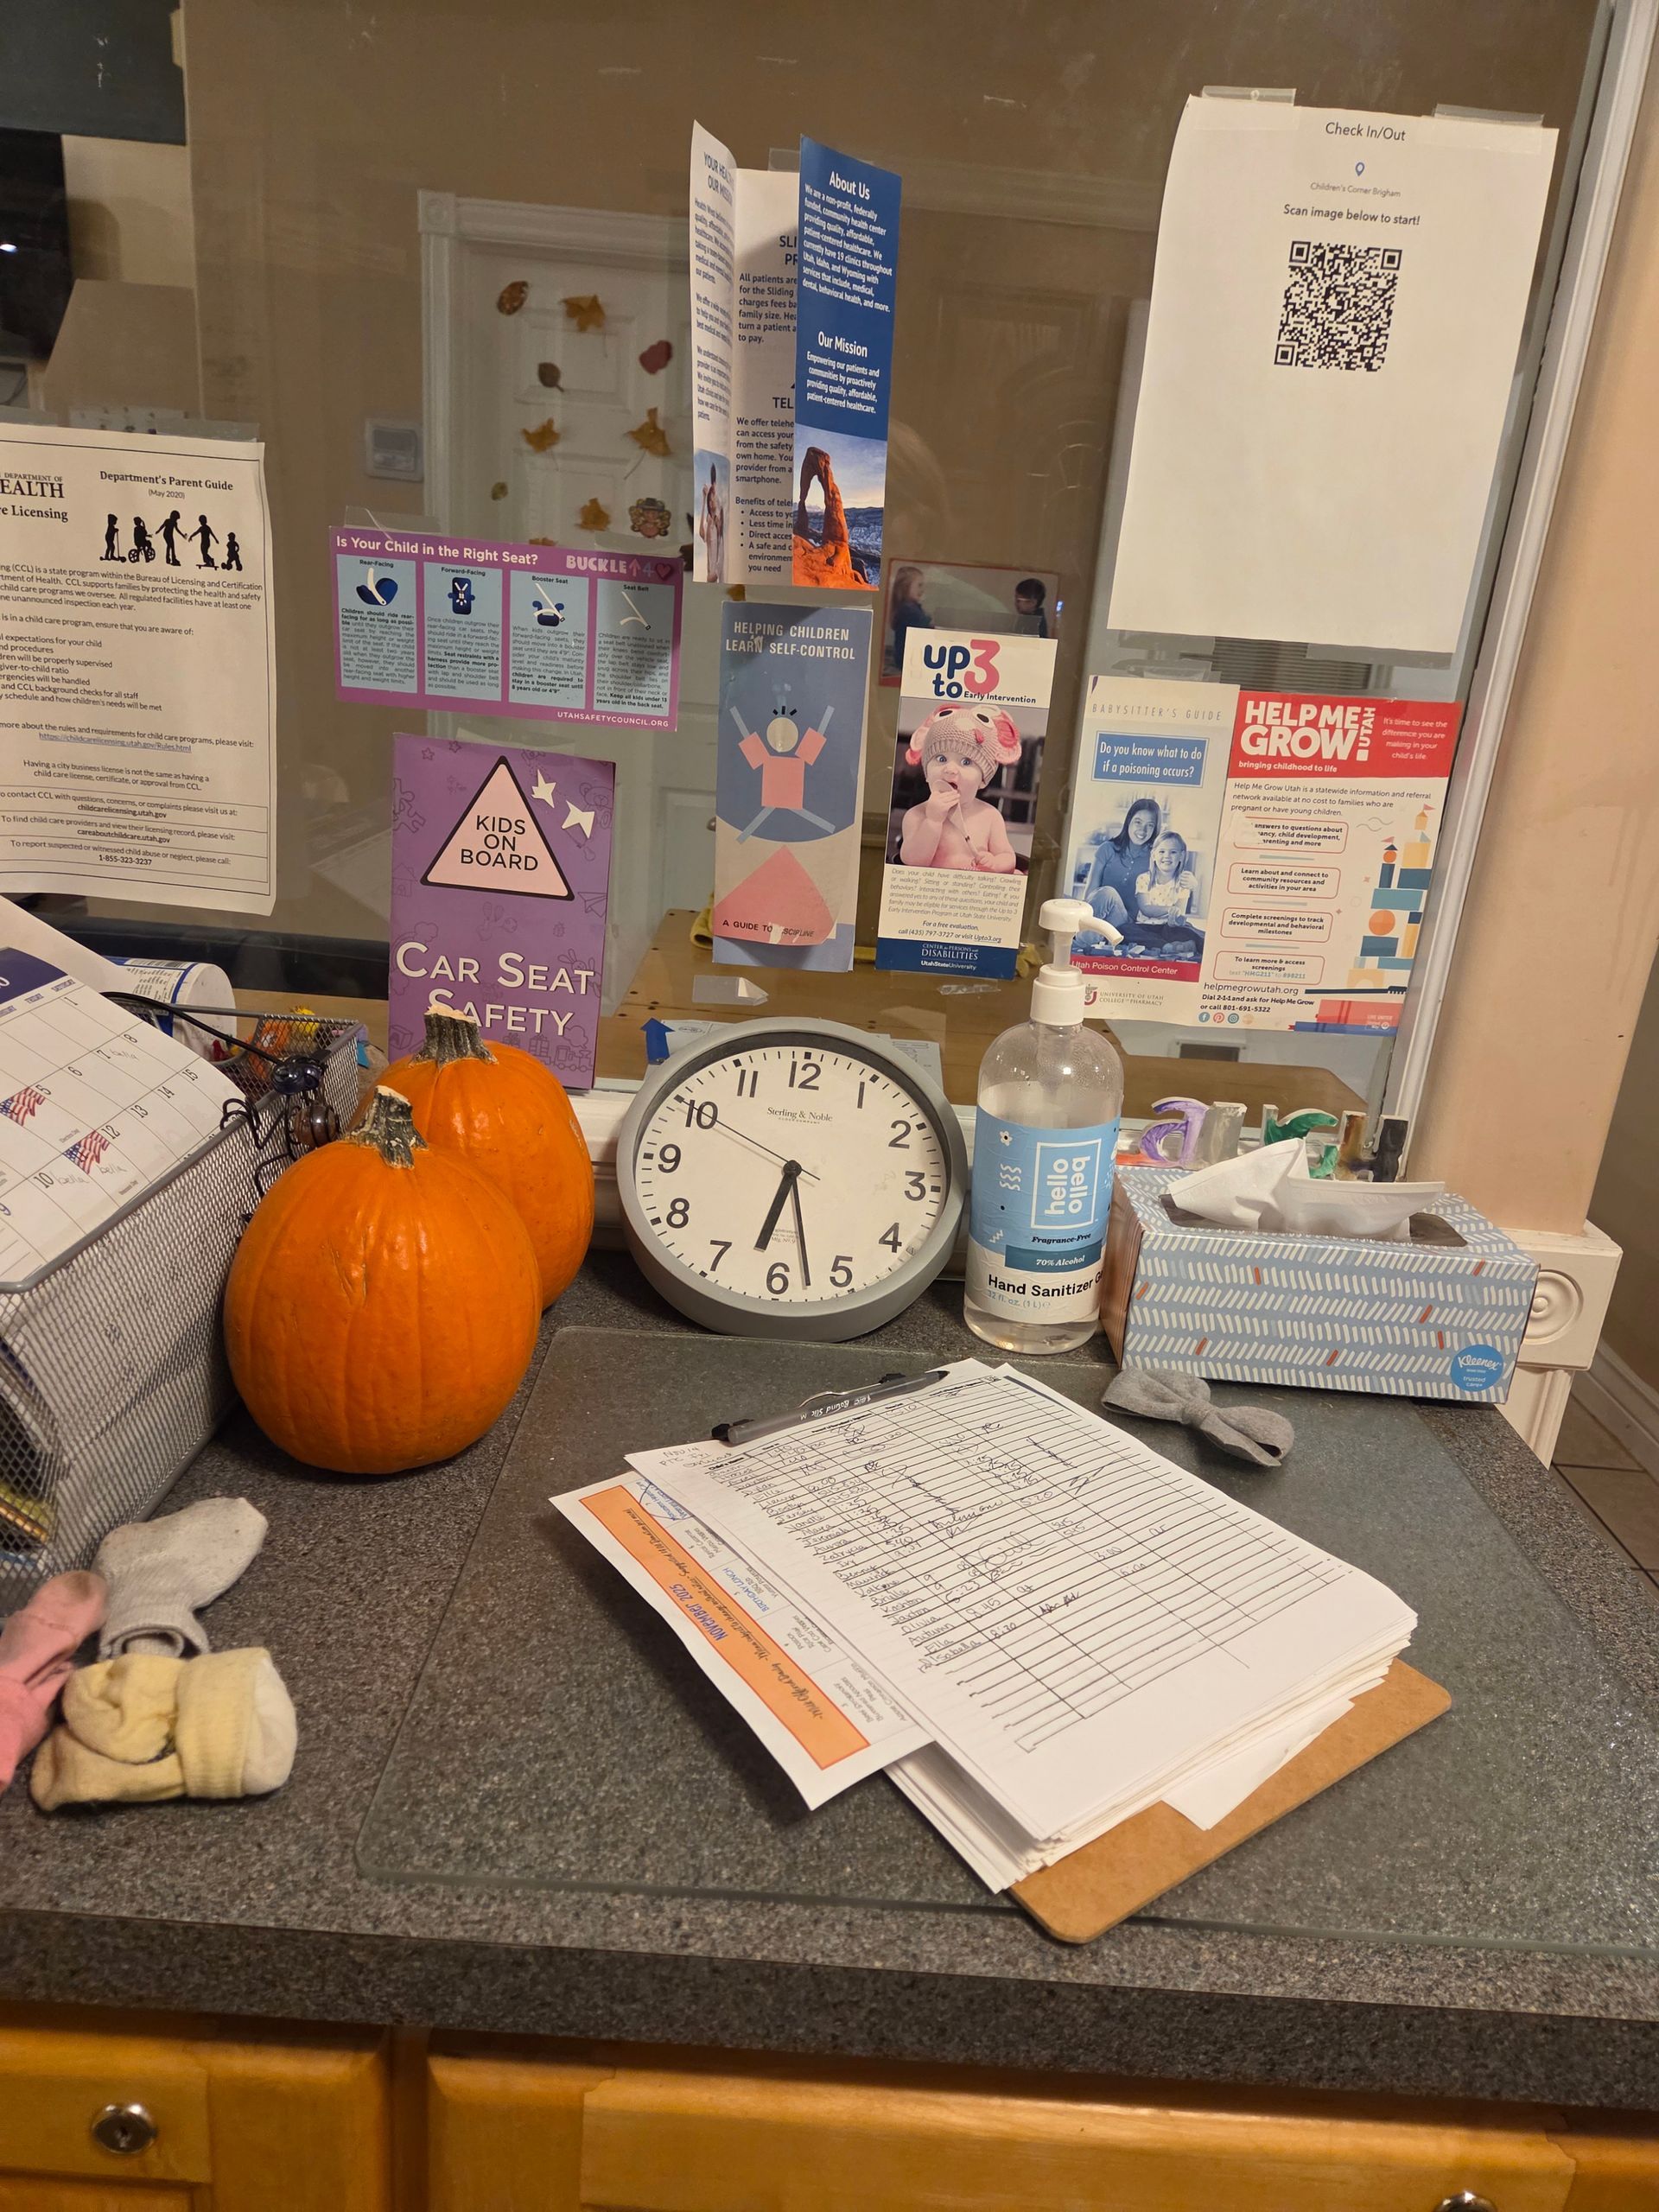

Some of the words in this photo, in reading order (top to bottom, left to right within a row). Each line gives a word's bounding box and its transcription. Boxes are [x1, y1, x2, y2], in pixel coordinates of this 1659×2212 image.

[1325, 122, 1363, 137] Check
[1367, 125, 1406, 141] In/Out
[830, 171, 856, 195] About
[859, 182, 870, 200] Us
[1310, 182, 1345, 192] Children's
[1347, 185, 1371, 194] Corner
[1372, 188, 1401, 198] Brigham
[1284, 204, 1307, 215] Scan
[1311, 207, 1343, 221] image
[1346, 208, 1378, 221] below
[1381, 213, 1390, 223] to
[1394, 215, 1420, 225] start!
[740, 273, 751, 282] All
[753, 276, 784, 284] patients
[766, 288, 793, 297] Sliding
[818, 331, 833, 348] Our
[835, 336, 868, 358] Mission
[807, 351, 836, 369] Empowering
[836, 360, 845, 370] our
[846, 364, 868, 375] patients
[868, 369, 880, 378] and
[770, 442, 792, 451] safety
[4, 473, 51, 481] DEPARTMENT
[99, 470, 167, 486] Department's
[169, 477, 203, 488] Parent
[205, 481, 233, 491] Guide
[0, 479, 65, 498] EALTH
[149, 489, 165, 498] (May
[167, 491, 185, 499] 2020)
[11, 505, 68, 523] Licensing
[337, 536, 346, 547] Is
[351, 537, 381, 550] Your
[385, 541, 419, 554] Child
[423, 543, 434, 555] in
[439, 545, 459, 557] the
[463, 548, 499, 562] Right
[502, 551, 538, 565] Seat?
[359, 559, 394, 568] Rear-Facing
[442, 567, 486, 576] Forward-Facing
[566, 555, 627, 574] BUCKLE
[734, 620, 784, 637] HELPING
[789, 625, 849, 641] CHILDREN
[726, 638, 763, 653] LEARN
[769, 642, 855, 660] SELF-CONTROL
[924, 645, 970, 679] up
[964, 639, 1001, 694] 3
[932, 673, 963, 698] to
[987, 693, 1036, 703] Intervention
[557, 711, 669, 728] UTAHSAFETYCOUNCIL.ORG
[1092, 703, 1177, 718] BABYSITTER'S
[1186, 710, 1222, 721] GUIDE
[1245, 701, 1318, 727] HELP
[1319, 705, 1362, 729] ME
[1358, 707, 1376, 747] UTAH
[1100, 742, 1111, 753] Do
[1114, 745, 1129, 756] you
[1132, 743, 1155, 756] know
[1157, 745, 1178, 759] what
[1180, 748, 1188, 759] to
[1191, 747, 1202, 760] do
[1240, 725, 1357, 761] GROW
[1103, 760, 1110, 772] if
[1112, 764, 1116, 772] a
[1119, 764, 1160, 778] poisoning
[1163, 766, 1194, 778] occurs?
[1239, 761, 1271, 770] bringing
[1274, 762, 1313, 772] childhood
[1234, 783, 1250, 791] Help
[1315, 786, 1348, 795] statewide
[1350, 787, 1389, 798] information
[1406, 791, 1431, 799] referral
[476, 815, 525, 836] KIDS
[77, 829, 170, 844] careaboutchildcare.utah.gov
[483, 833, 516, 852] ON
[99, 855, 152, 866] 1-855-323-3237
[461, 849, 538, 871] BOARD
[734, 921, 759, 930] GUIDE
[925, 930, 953, 938] 797-3727
[975, 934, 1001, 944] Upto3.org
[921, 949, 978, 960] DISABILITIES
[396, 941, 480, 984] CAR
[497, 952, 594, 995] SEAT
[921, 960, 976, 969] UtahStateUniversity
[1071, 961, 1090, 969] Utah
[1204, 982, 1299, 995] helpmegrowutah.org
[64, 996, 78, 1006] 1
[124, 1033, 138, 1044] 8
[96, 1050, 111, 1059] 7
[182, 1068, 198, 1081] 15
[737, 1070, 759, 1097] 11
[788, 1060, 821, 1090] 12
[157, 1086, 175, 1099] 14
[857, 1081, 865, 1109] 1
[130, 1104, 149, 1118] 13
[685, 1099, 718, 1130] 10
[767, 1107, 798, 1119] Sterling
[809, 1112, 833, 1122] Noble
[101, 1125, 121, 1140] 12
[888, 1120, 911, 1149] 2
[658, 1144, 681, 1173] 9
[34, 1172, 54, 1188] 10
[905, 1172, 926, 1201] 3
[1045, 1159, 1069, 1216] hello
[1068, 1156, 1090, 1214] hello
[666, 1198, 690, 1229] 8
[878, 1223, 902, 1253] 4
[1032, 1233, 1091, 1245] Fragrance-Free
[709, 1240, 732, 1272] 7
[1055, 1255, 1084, 1266] Alcohol
[766, 1262, 790, 1294] 6
[830, 1255, 853, 1287] 5
[988, 1274, 1026, 1295] Hand
[1032, 1279, 1093, 1297] Sanitizer
[1458, 1355, 1499, 1370] Kleenex
[722, 1567, 744, 1588] LUNCH
[669, 1584, 693, 1602] 2025
[742, 1587, 769, 1612] BIRTHDAY
